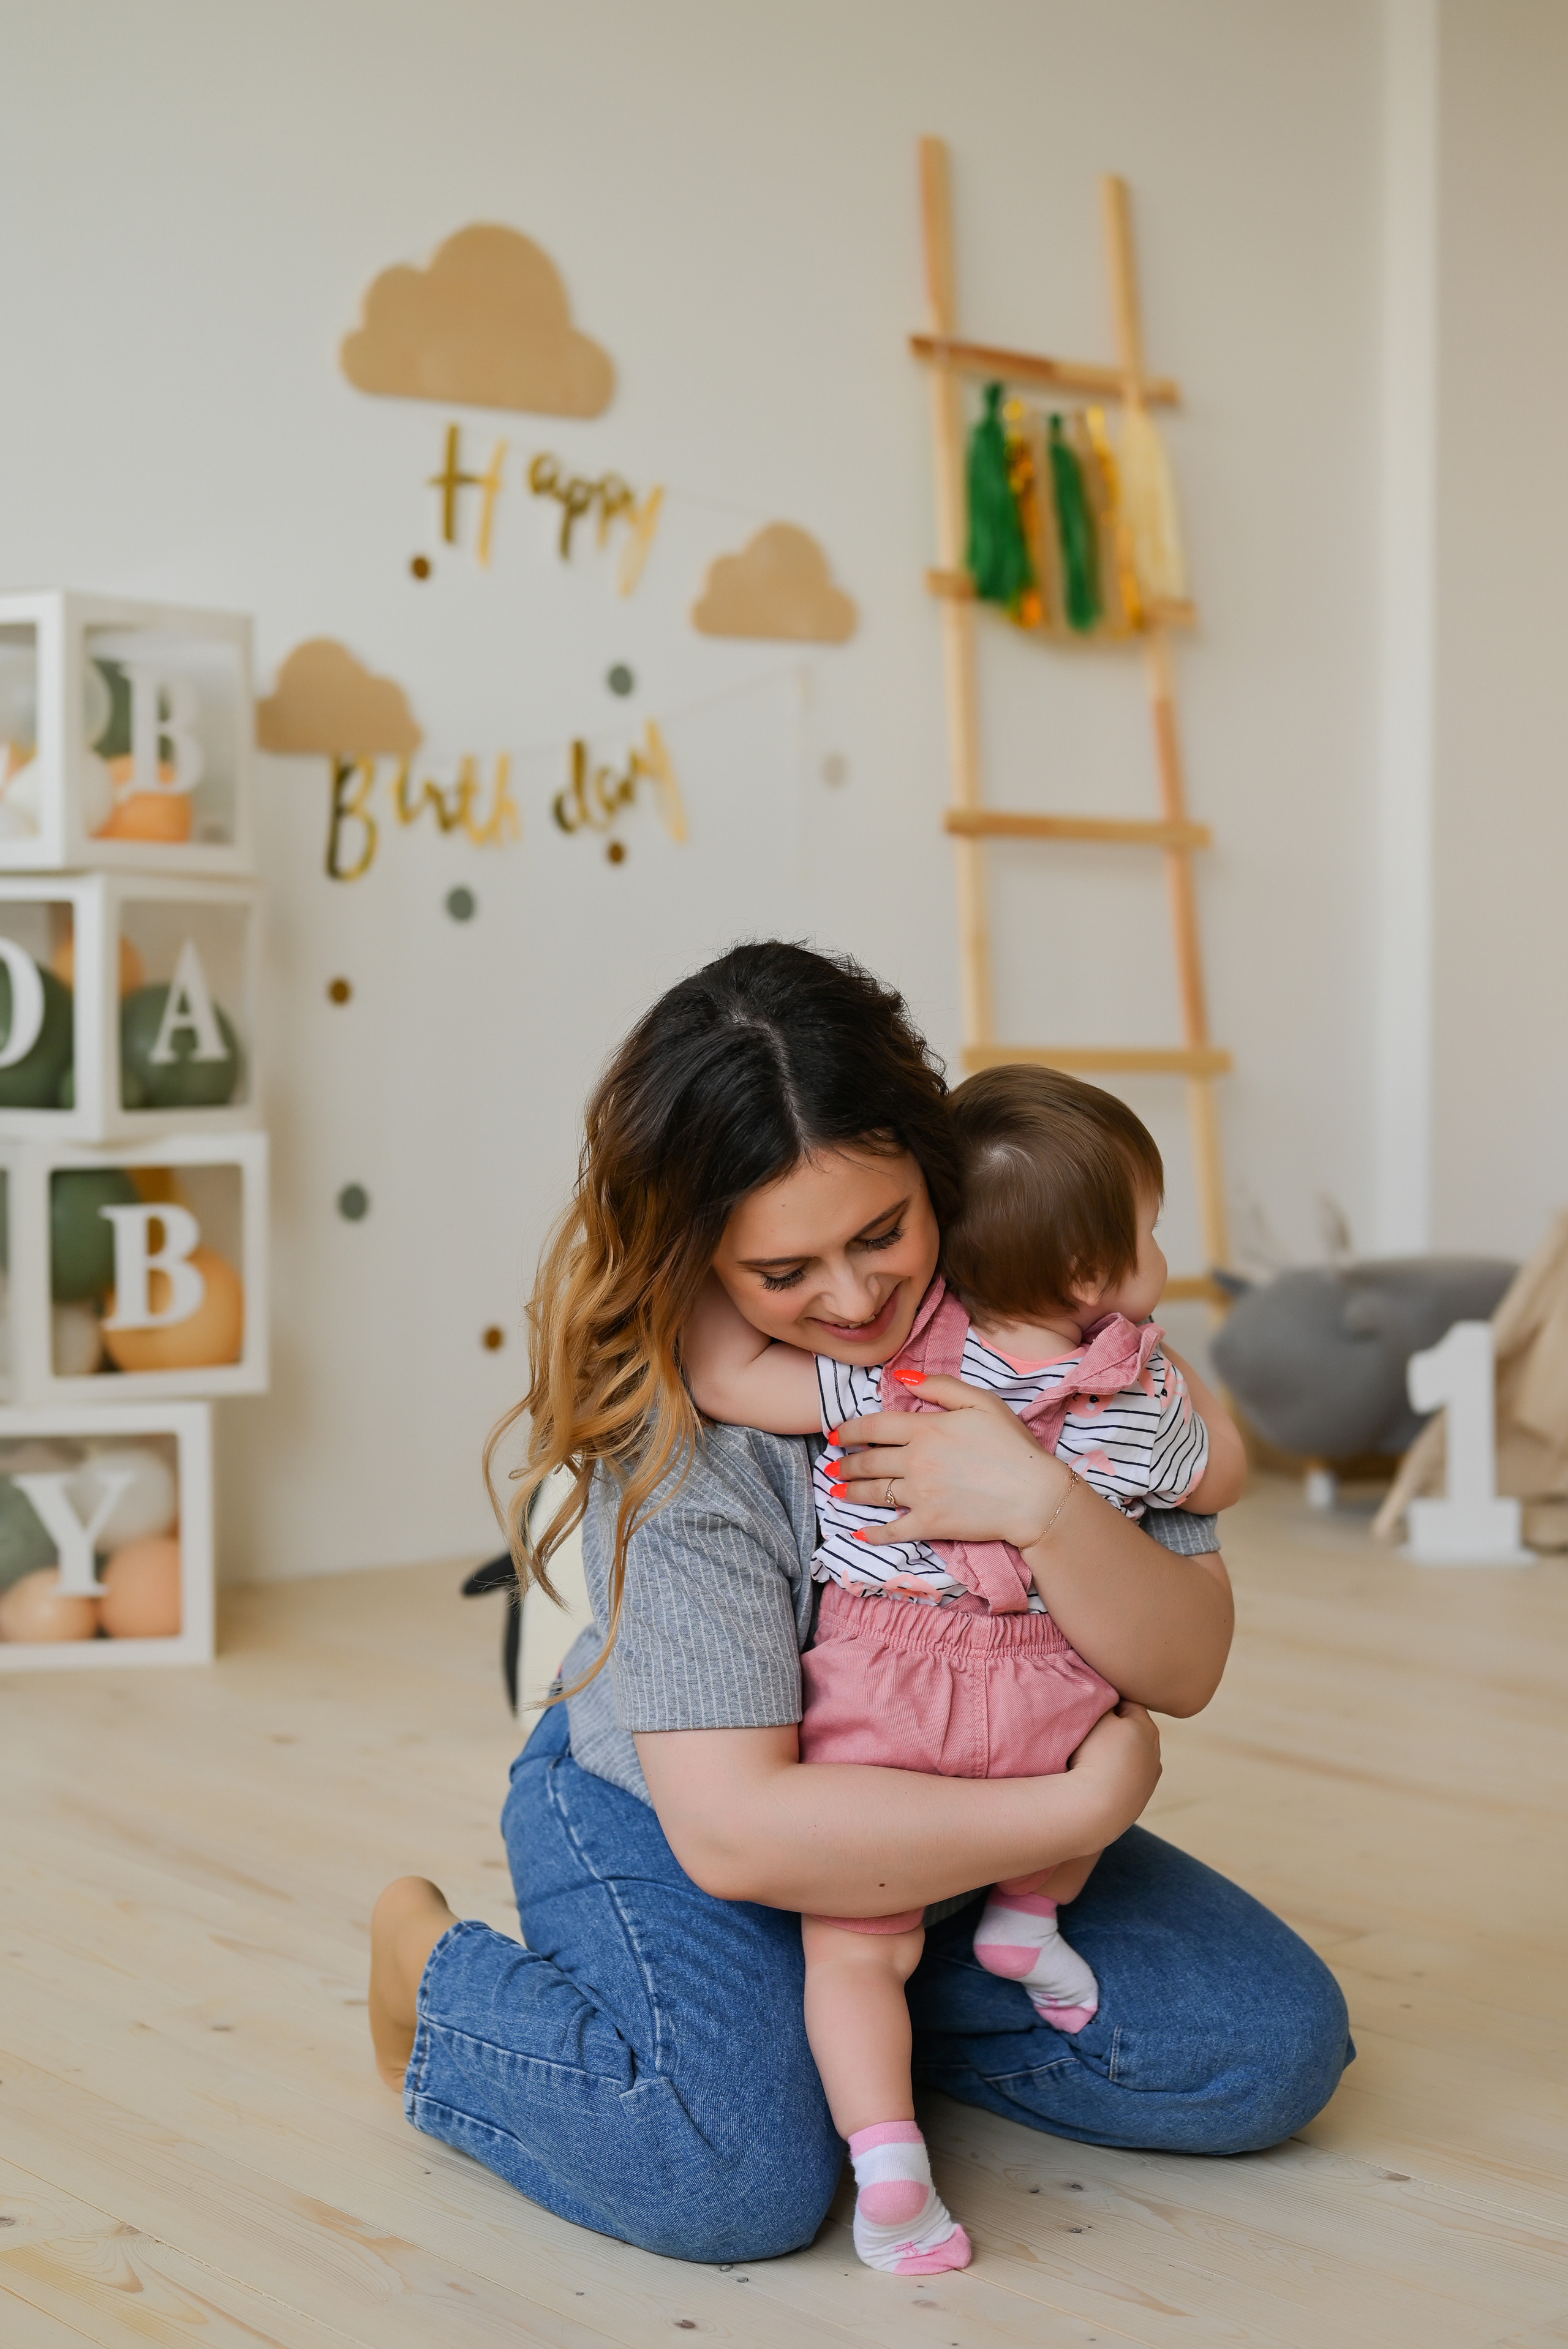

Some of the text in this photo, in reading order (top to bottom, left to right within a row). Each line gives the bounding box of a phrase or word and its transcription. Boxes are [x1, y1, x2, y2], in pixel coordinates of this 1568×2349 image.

[428, 423, 664, 598] Happy
[118, 666, 203, 801] B
[149, 938, 228, 1065] A
[100, 1203, 205, 1330] B
[1408, 1319, 1523, 1564] 1
[13, 1474, 130, 1596] Y
